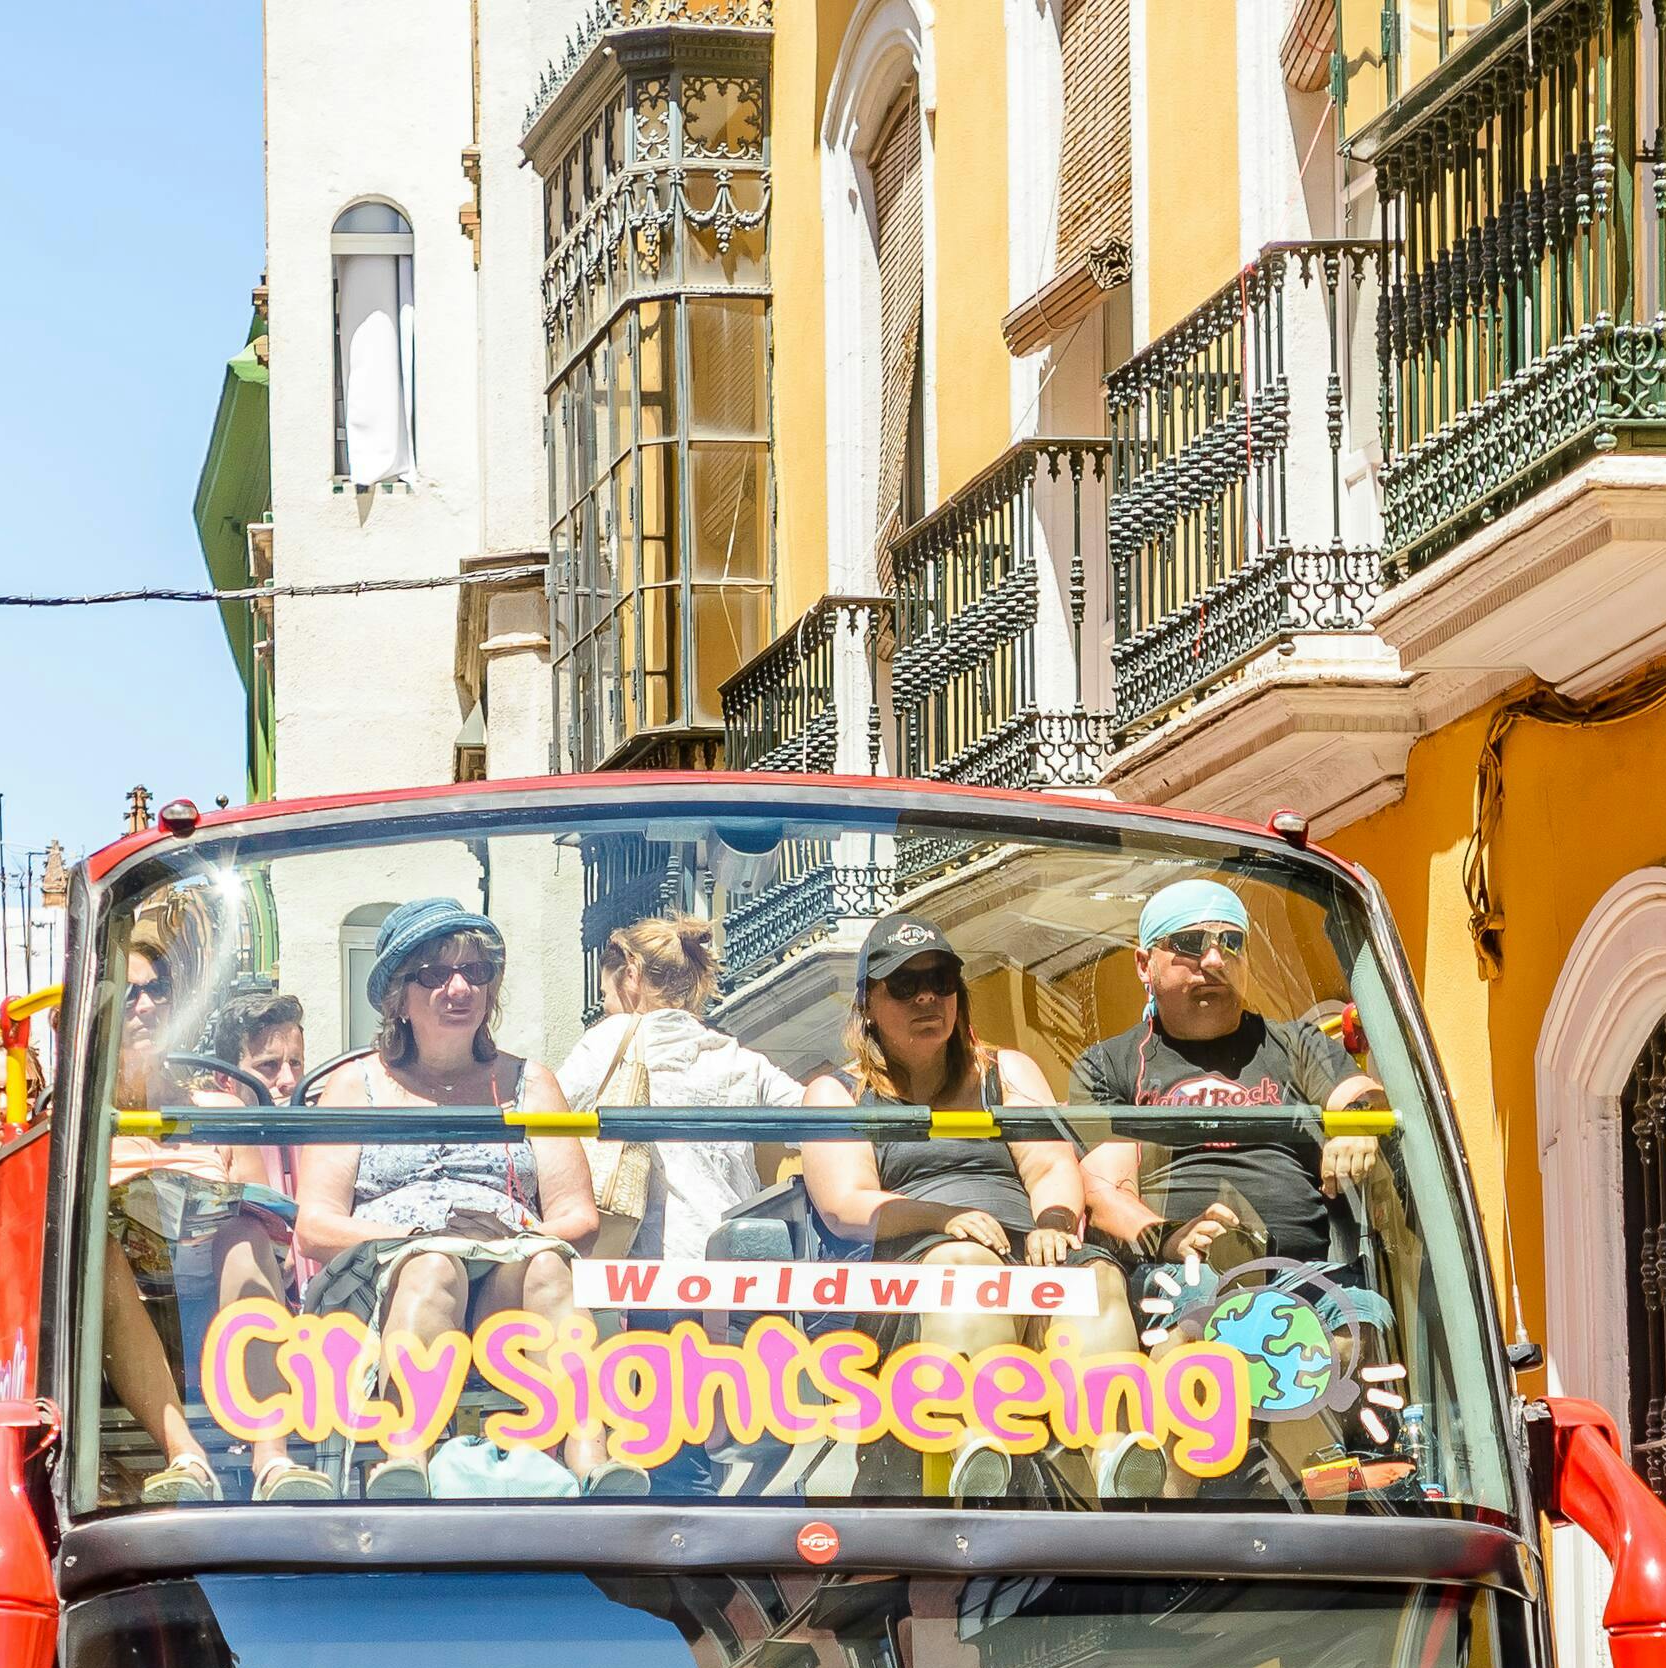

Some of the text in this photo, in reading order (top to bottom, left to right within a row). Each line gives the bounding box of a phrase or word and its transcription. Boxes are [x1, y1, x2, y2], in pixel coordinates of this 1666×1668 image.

[604, 1264, 1067, 1310] Worldwide
[205, 1303, 471, 1449] City
[477, 1313, 1244, 1475] Sightseeing
